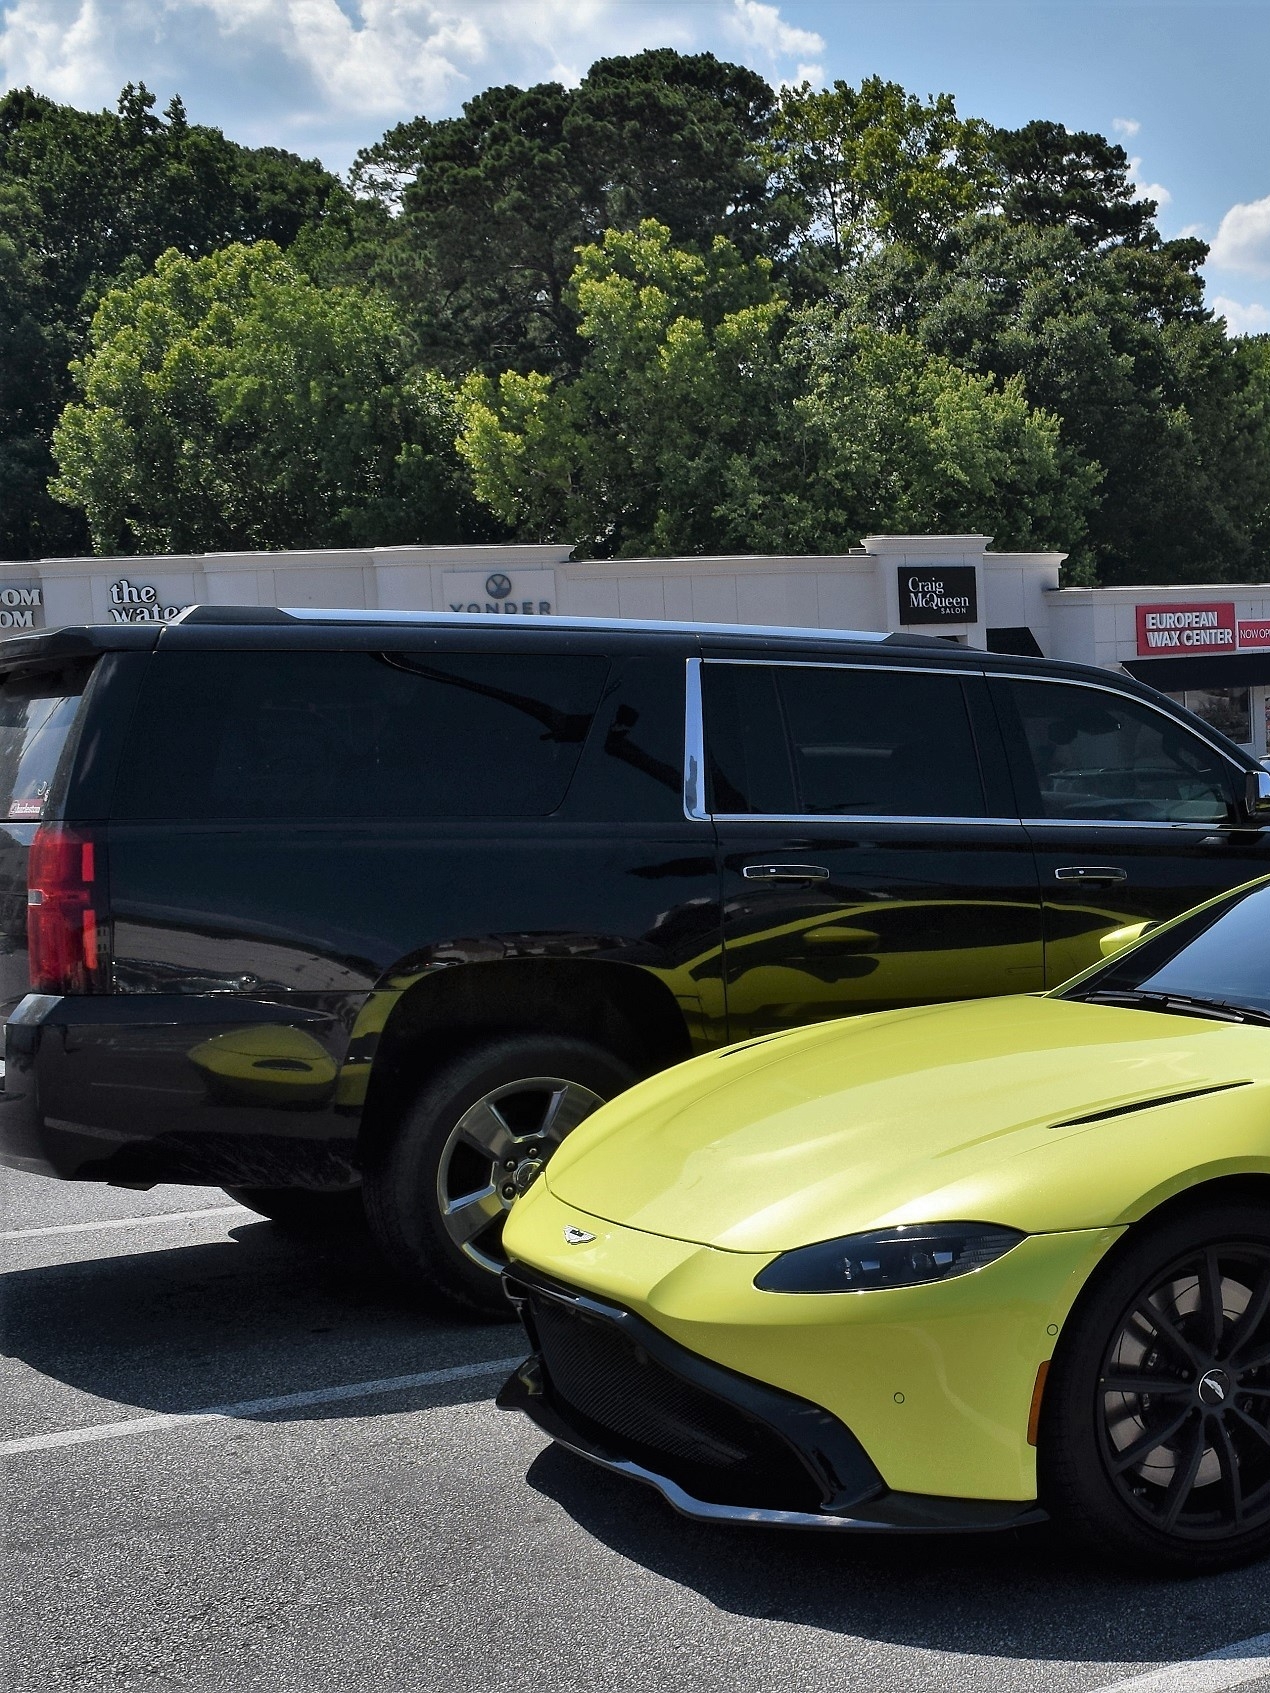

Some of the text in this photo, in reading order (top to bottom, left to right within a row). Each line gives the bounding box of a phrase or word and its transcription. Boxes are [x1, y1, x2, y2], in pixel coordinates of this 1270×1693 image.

[110, 579, 156, 604] the
[908, 576, 944, 594] Craig
[0, 589, 42, 606] OM
[909, 592, 969, 609] McQueen
[109, 603, 185, 622] wate
[449, 601, 551, 615] YONDER
[1145, 611, 1218, 629] EUROPEAN
[1146, 628, 1234, 648] WAX CENTER
[1240, 629, 1259, 639] NOW
